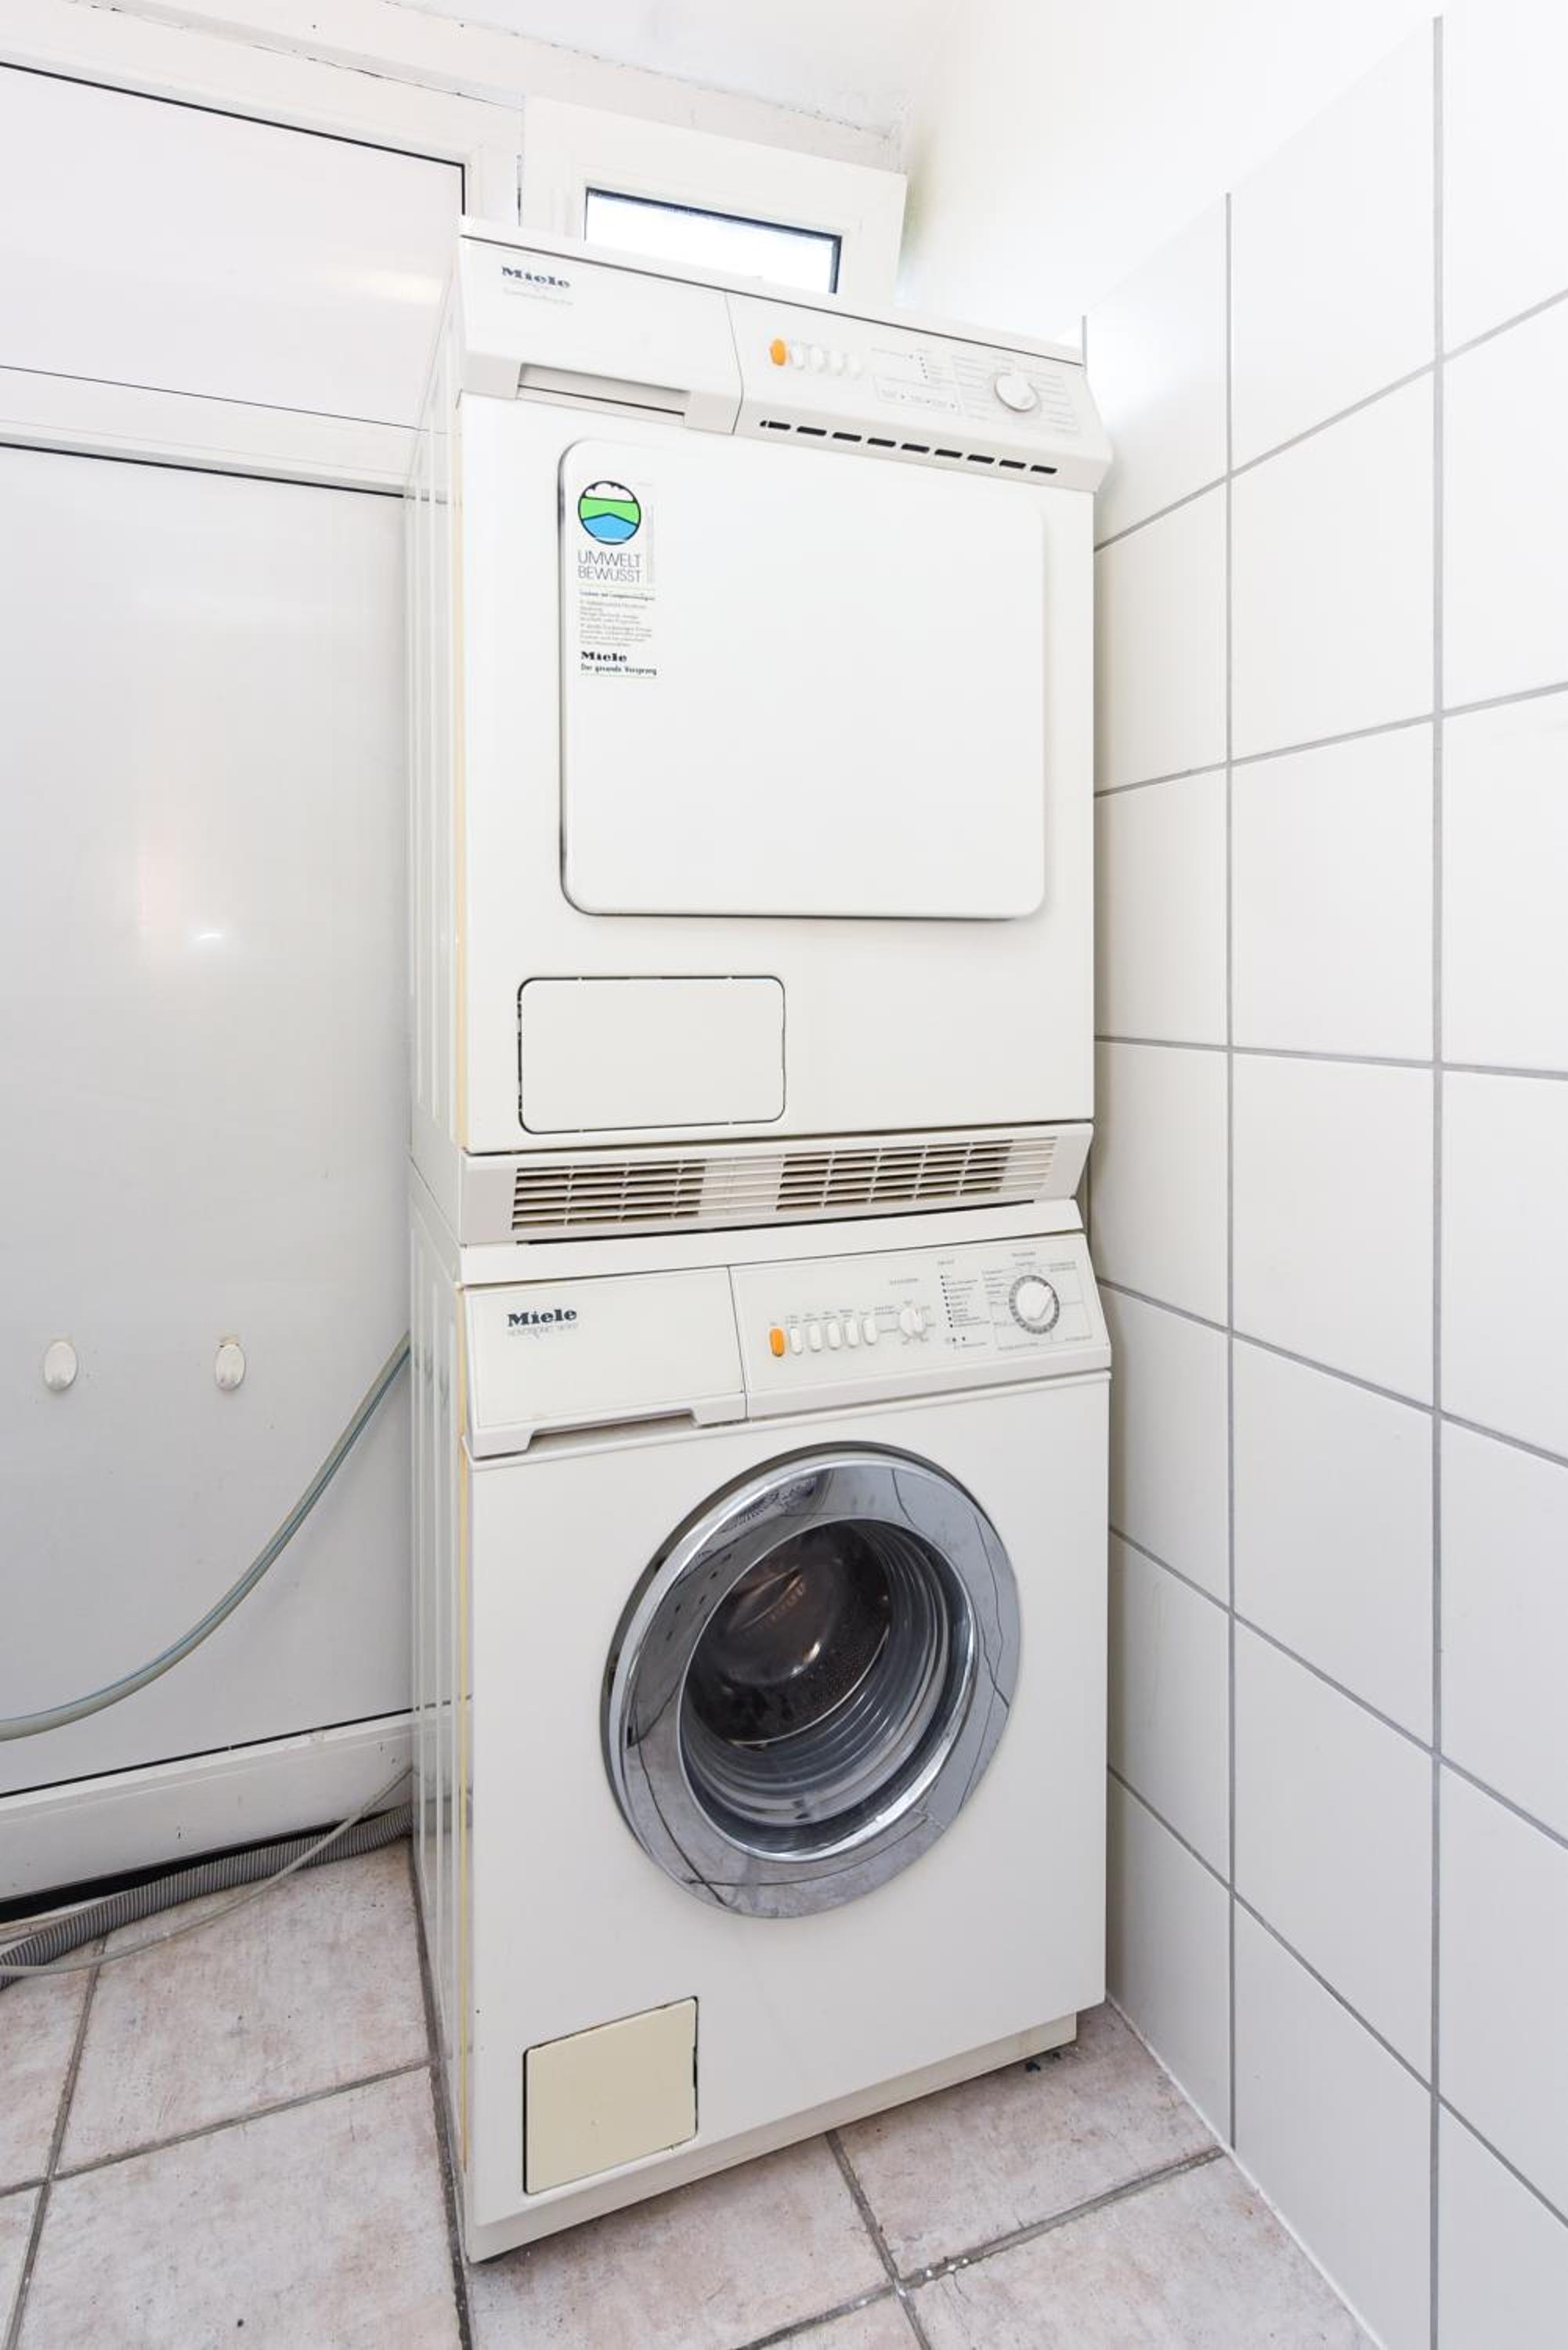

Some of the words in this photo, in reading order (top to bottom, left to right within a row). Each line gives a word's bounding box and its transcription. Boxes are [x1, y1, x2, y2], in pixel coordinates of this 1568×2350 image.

[502, 266, 570, 287] Miele
[577, 549, 641, 567] UMWELT
[577, 566, 641, 584] BEWUSST
[581, 651, 627, 662] Miele
[508, 1308, 577, 1328] Miele
